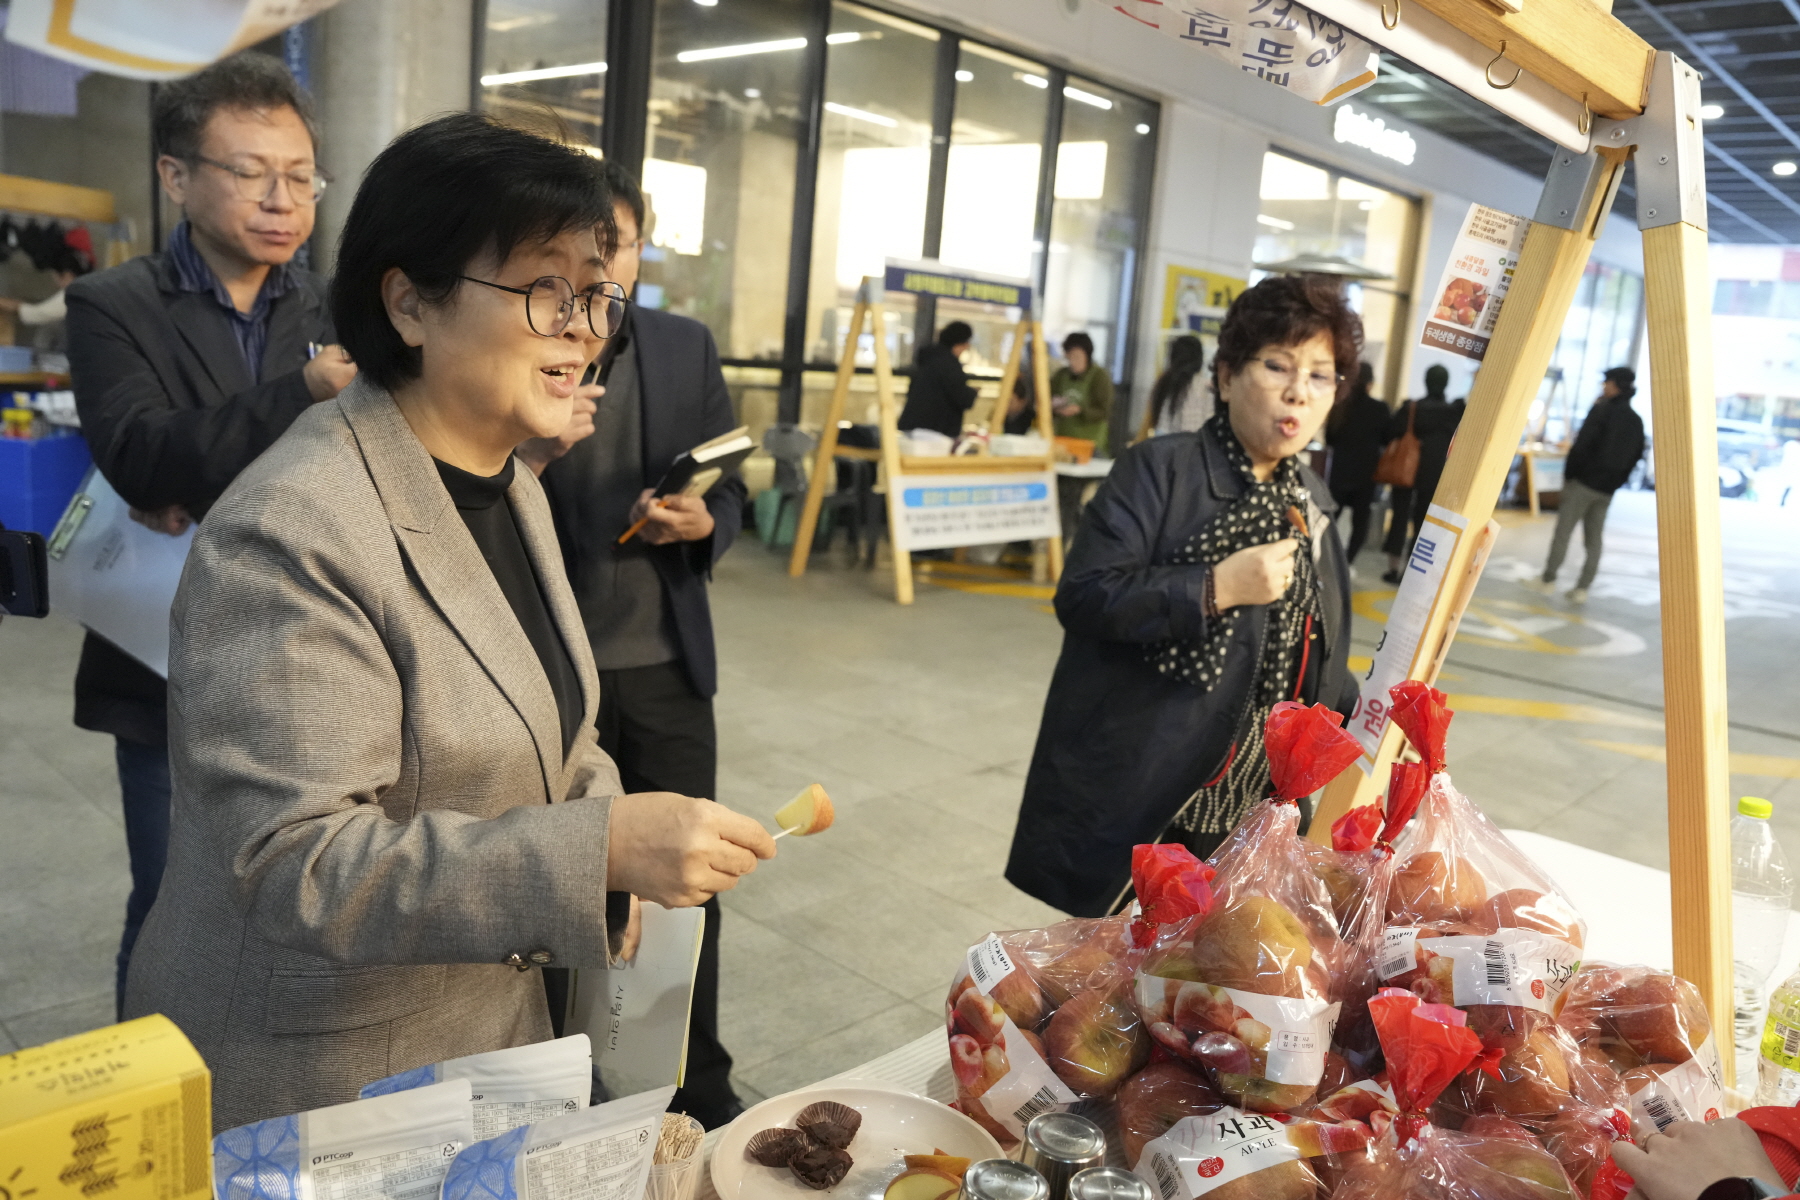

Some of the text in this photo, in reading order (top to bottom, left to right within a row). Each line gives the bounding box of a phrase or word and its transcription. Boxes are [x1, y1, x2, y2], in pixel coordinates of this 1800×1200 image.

[1455, 259, 1490, 277] 친환경 과일
[1425, 327, 1484, 354] 두레생협 종암점
[1217, 1115, 1275, 1139] 사과
[323, 1151, 354, 1162] PTCoop
[1241, 1138, 1277, 1157] APPLE
